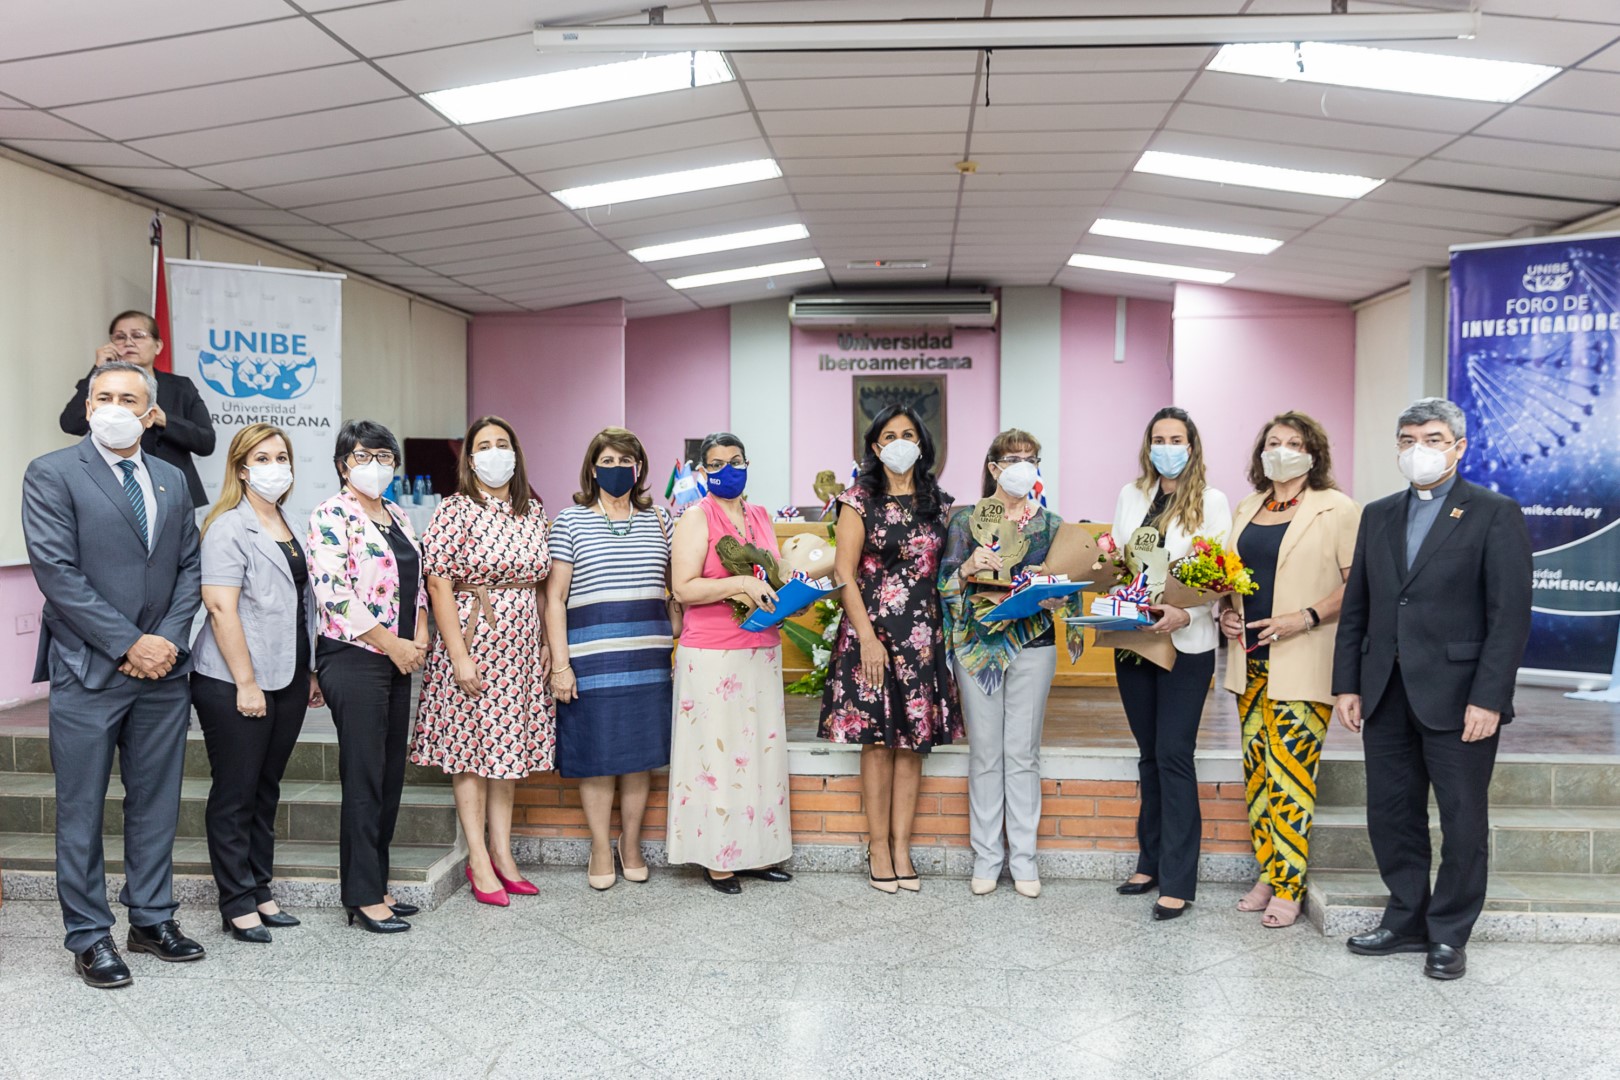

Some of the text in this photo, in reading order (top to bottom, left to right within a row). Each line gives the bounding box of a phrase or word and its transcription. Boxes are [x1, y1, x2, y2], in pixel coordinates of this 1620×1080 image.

[1526, 262, 1570, 275] UNIBE
[1506, 294, 1589, 315] FORO DE
[1462, 311, 1620, 339] INVESTIGADORE
[209, 329, 307, 356] UNIBE
[837, 333, 953, 350] Universidad
[818, 354, 972, 371] Iberoamericana
[222, 401, 296, 414] Universidad
[989, 504, 1003, 515] 20
[1143, 533, 1157, 544] 20
